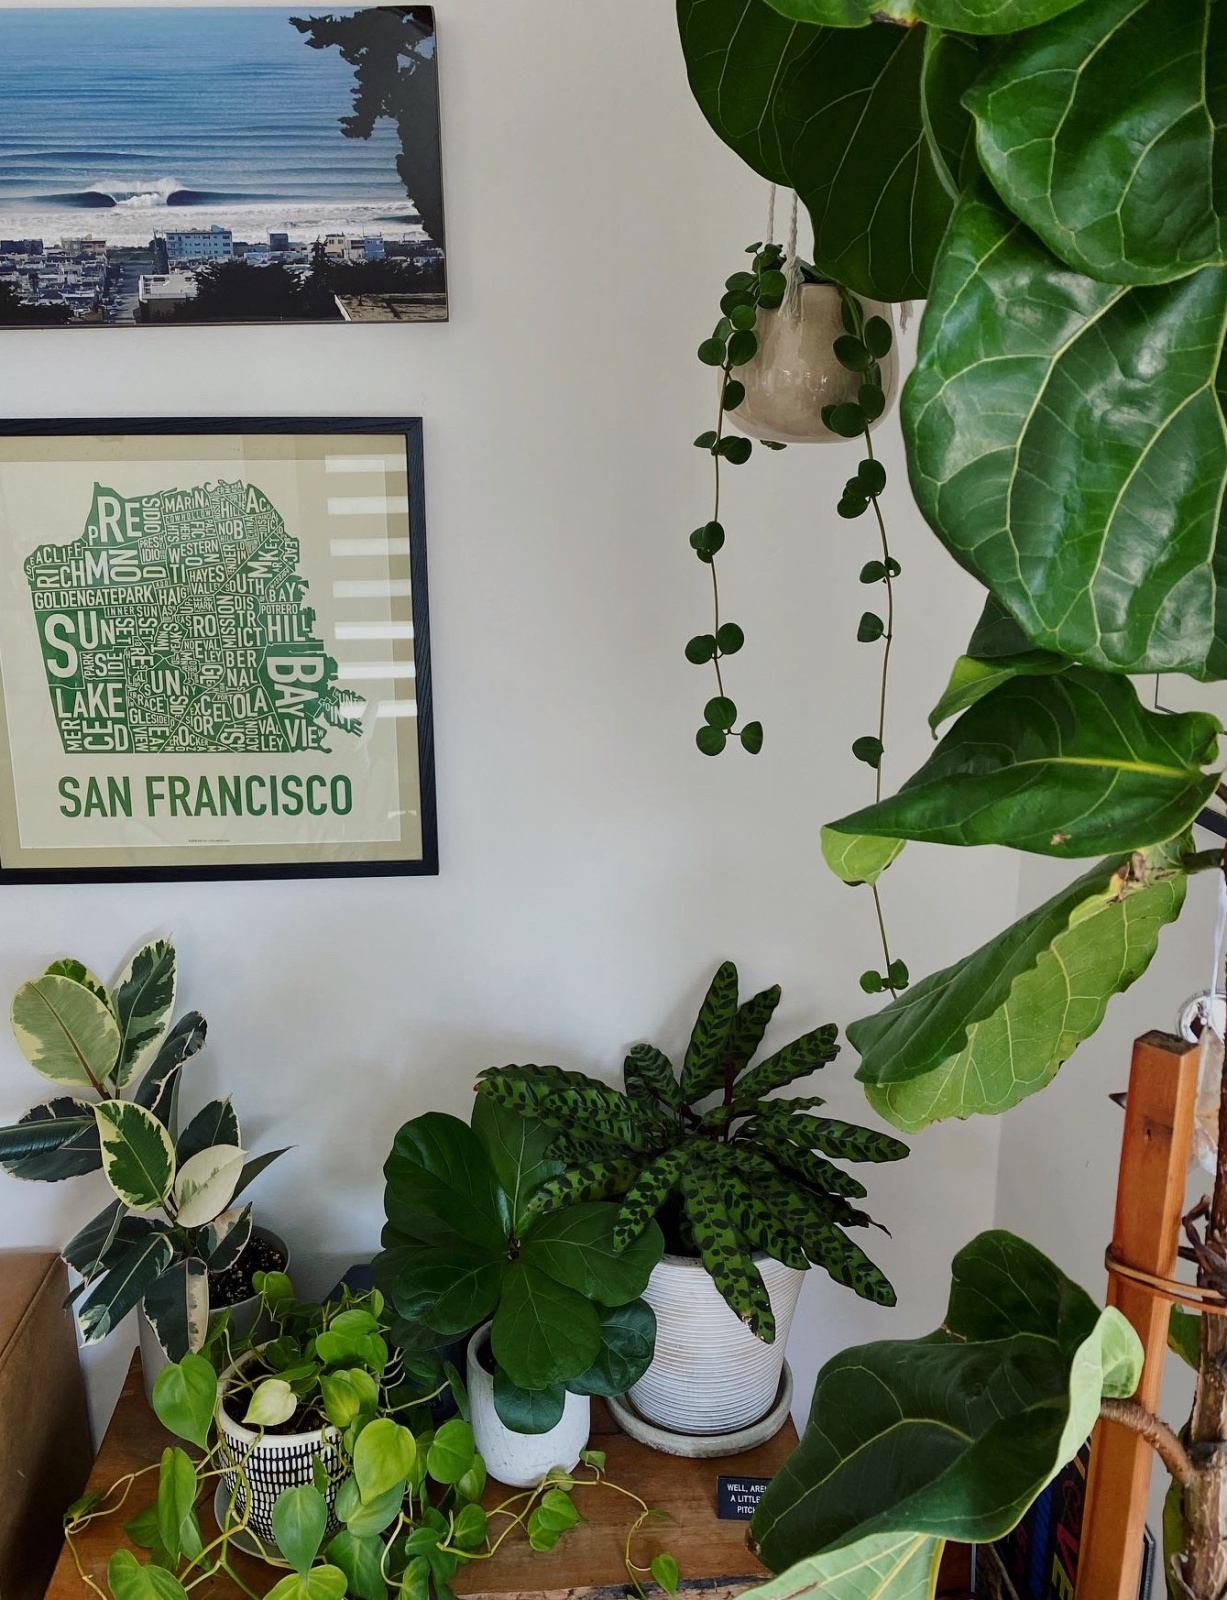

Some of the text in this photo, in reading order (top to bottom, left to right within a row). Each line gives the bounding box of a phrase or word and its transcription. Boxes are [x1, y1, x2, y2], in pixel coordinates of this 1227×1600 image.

[164, 491, 210, 513] MARINA
[218, 520, 244, 540] NOB
[26, 542, 81, 575] SEACLIFF
[190, 564, 225, 583] HAYES
[226, 573, 265, 596] SOUTH
[190, 582, 221, 595] VALLEY
[269, 582, 296, 603] BAY
[107, 606, 135, 616] INNER
[261, 603, 298, 615] POTRERO
[216, 595, 238, 648] MISSION
[267, 614, 310, 642] HILL
[267, 656, 324, 718] BAY
[55, 683, 126, 719] LAKE
[283, 719, 325, 748] VIEW
[58, 774, 353, 818] SAN FRANCISCO
[727, 1483, 748, 1493] WELL,
[730, 1494, 761, 1504] A LITTLE
